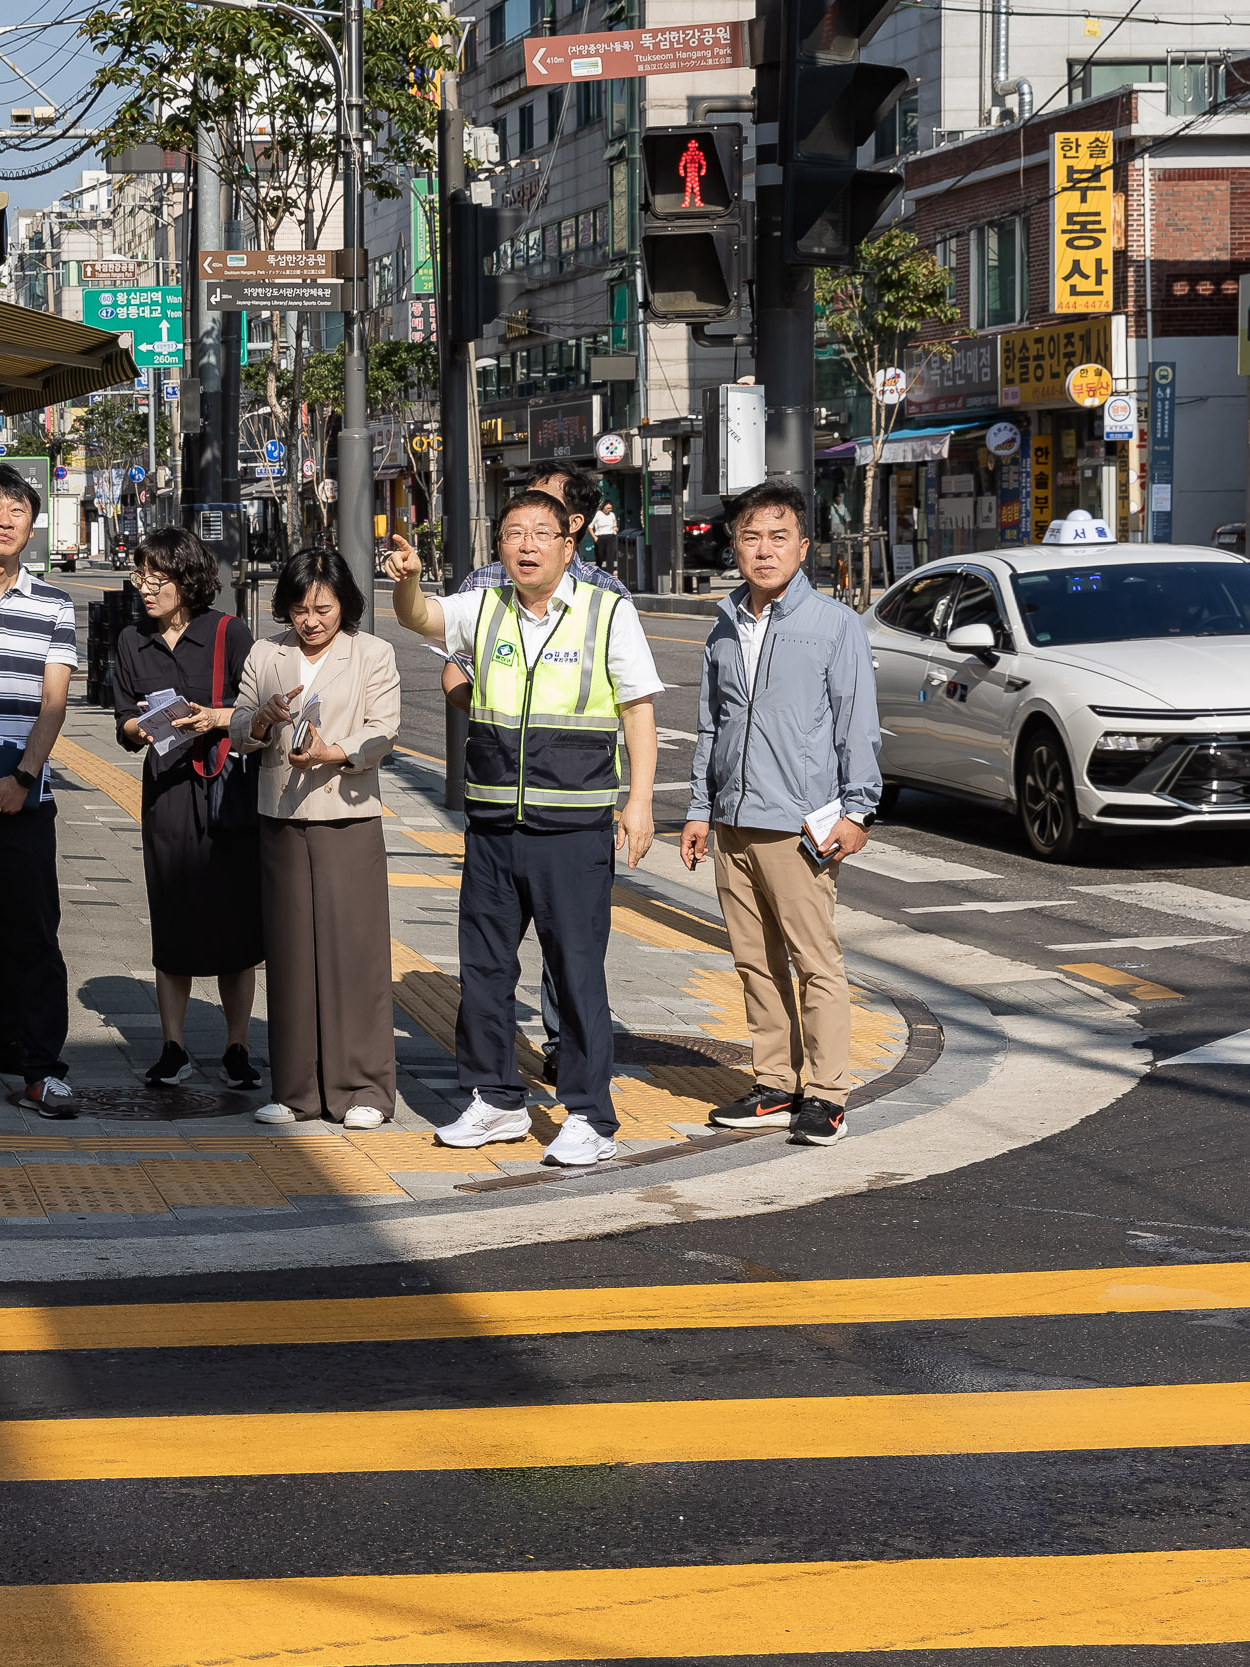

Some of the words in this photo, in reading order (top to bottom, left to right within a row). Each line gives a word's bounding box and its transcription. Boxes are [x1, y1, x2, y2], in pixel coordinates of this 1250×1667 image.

[567, 41, 634, 55] (자양중앙나들목)
[639, 25, 732, 51] 뚝섬한강공원
[545, 56, 565, 65] 410m
[634, 52, 674, 63] Ttukseom
[676, 49, 711, 60] Hangang
[713, 47, 732, 56] Park
[1060, 136, 1108, 160] 한솔
[1061, 164, 1108, 297] 부동산
[266, 254, 326, 267] 뚝섬한강공원
[116, 291, 162, 305] 왕십리역
[1057, 301, 1110, 310] 444-4474
[100, 309, 112, 317] 47
[116, 306, 162, 319] 영동대교
[153, 355, 179, 364] 260m
[1003, 325, 1110, 386] 한솔공인중개사
[930, 345, 991, 388] 복권판매점
[1073, 381, 1110, 398] 부동산
[1073, 526, 1108, 540] 서울
